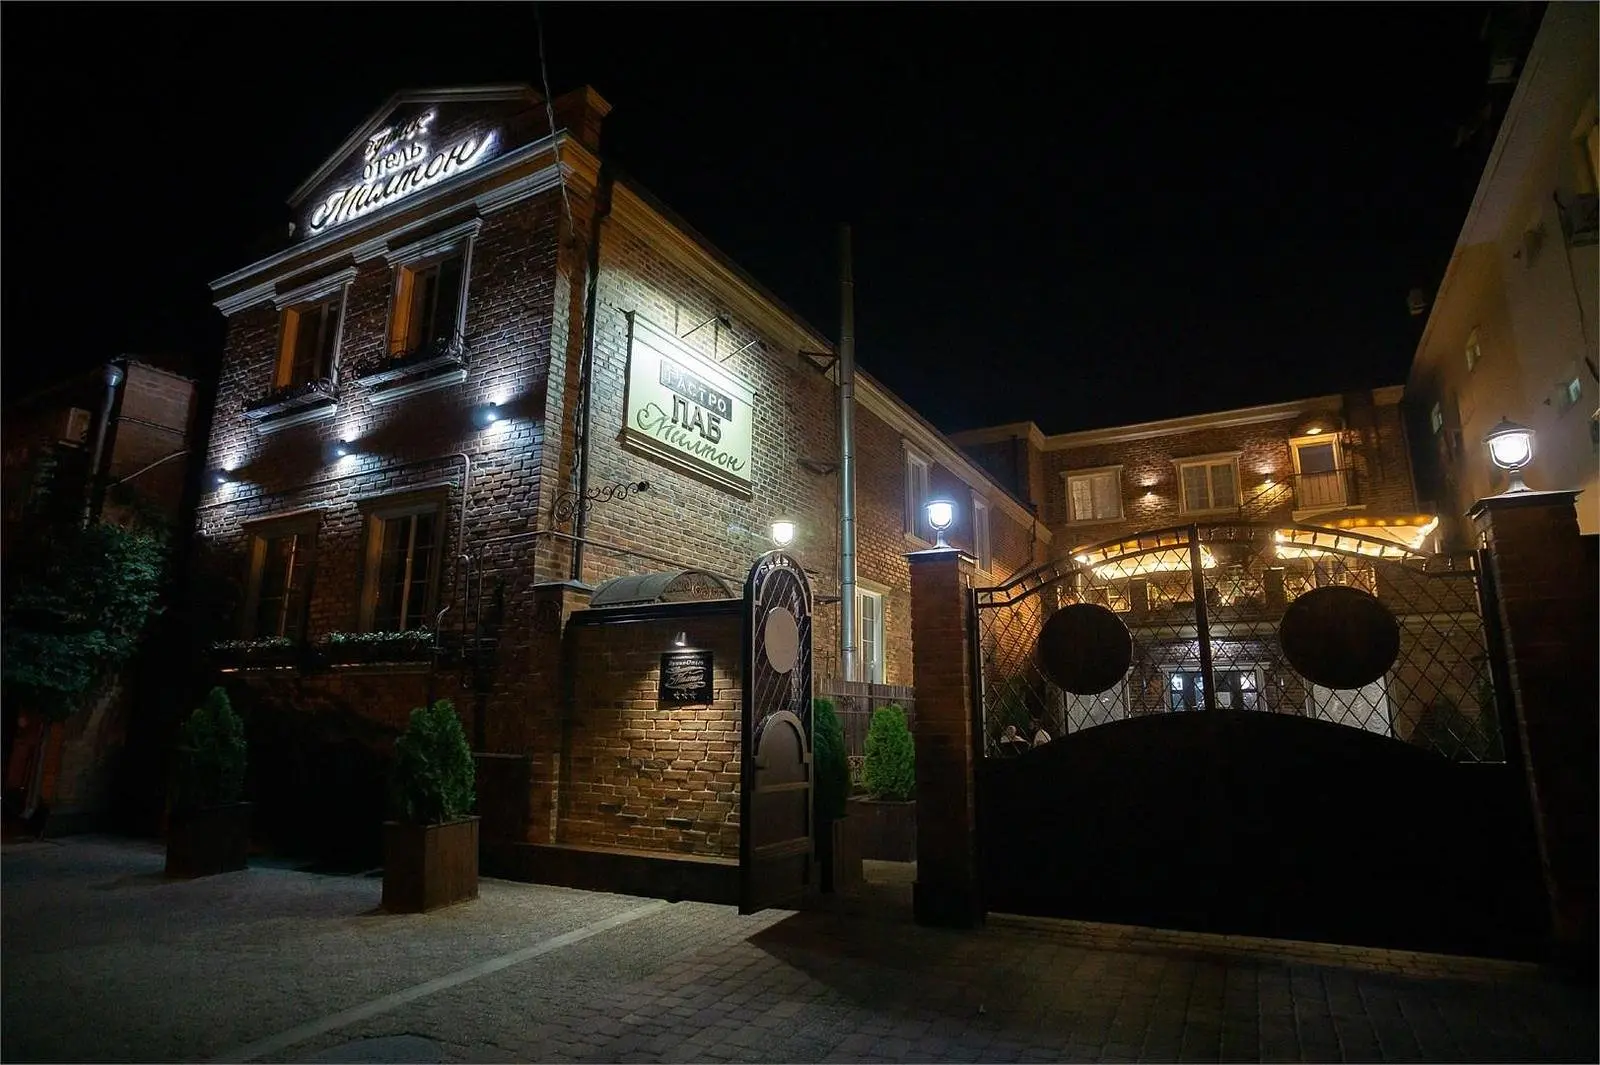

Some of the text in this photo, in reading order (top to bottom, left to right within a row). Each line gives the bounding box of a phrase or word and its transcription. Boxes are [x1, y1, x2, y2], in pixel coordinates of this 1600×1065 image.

[310, 132, 490, 228] Милтон
[667, 367, 727, 413] ГАСТРО
[671, 394, 722, 445] ПАБ
[636, 402, 745, 472] Милтон
